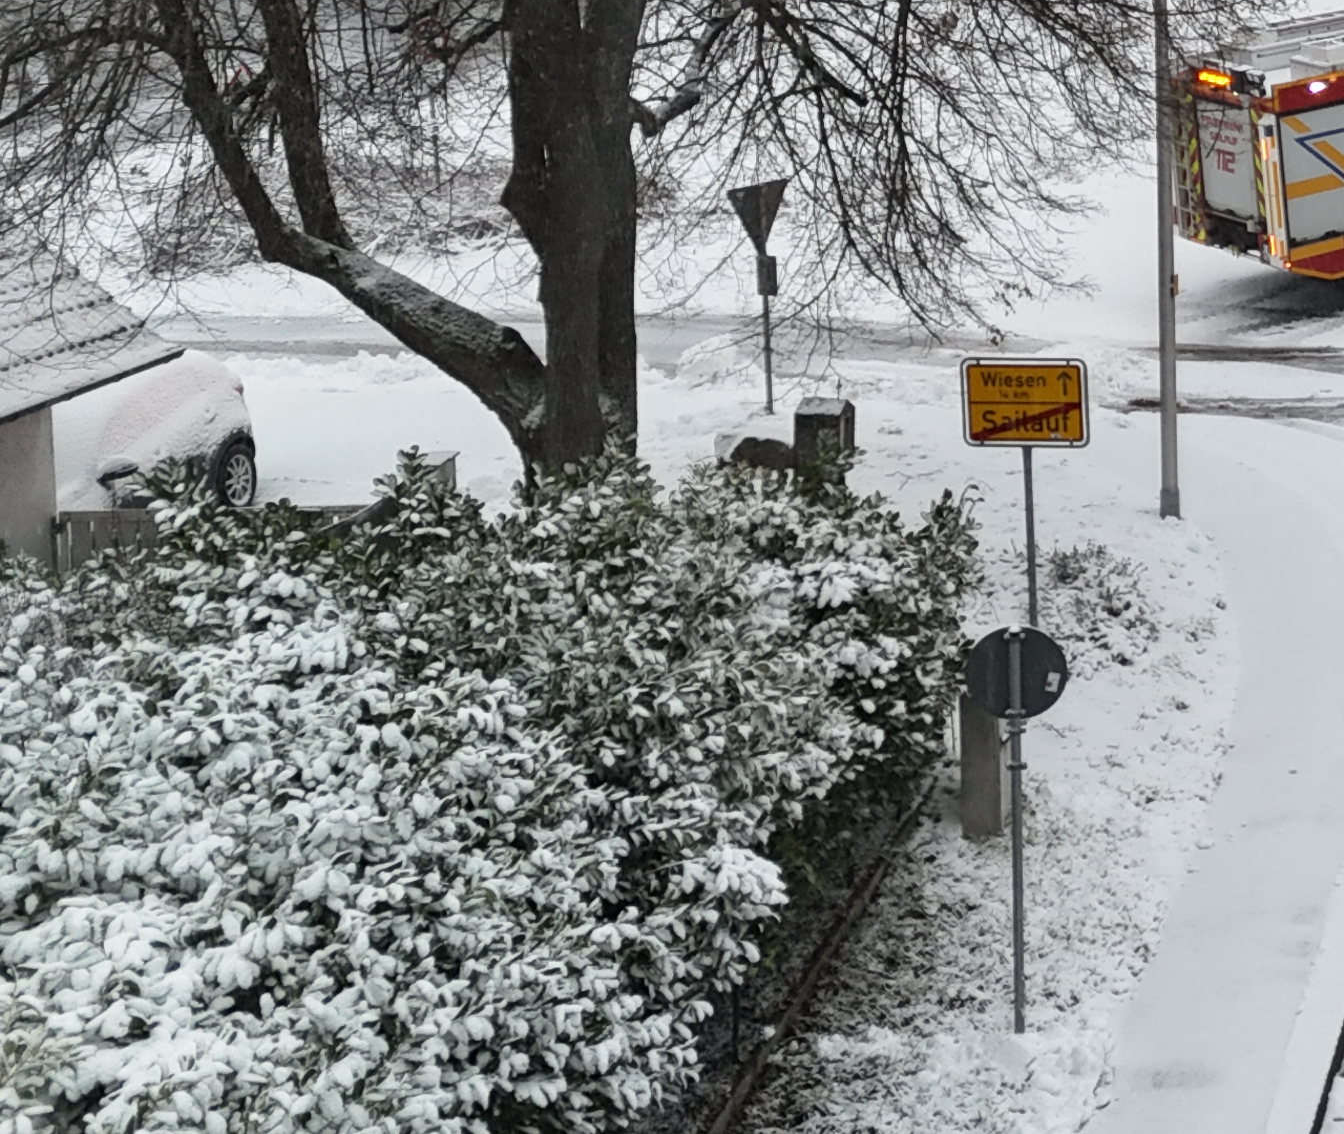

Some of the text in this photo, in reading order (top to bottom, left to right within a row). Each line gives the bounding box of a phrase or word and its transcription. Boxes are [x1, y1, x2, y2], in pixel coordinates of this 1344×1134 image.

[1216, 148, 1236, 174] 112
[981, 371, 1047, 388] Wiesen
[981, 410, 1070, 434] Sailauf
